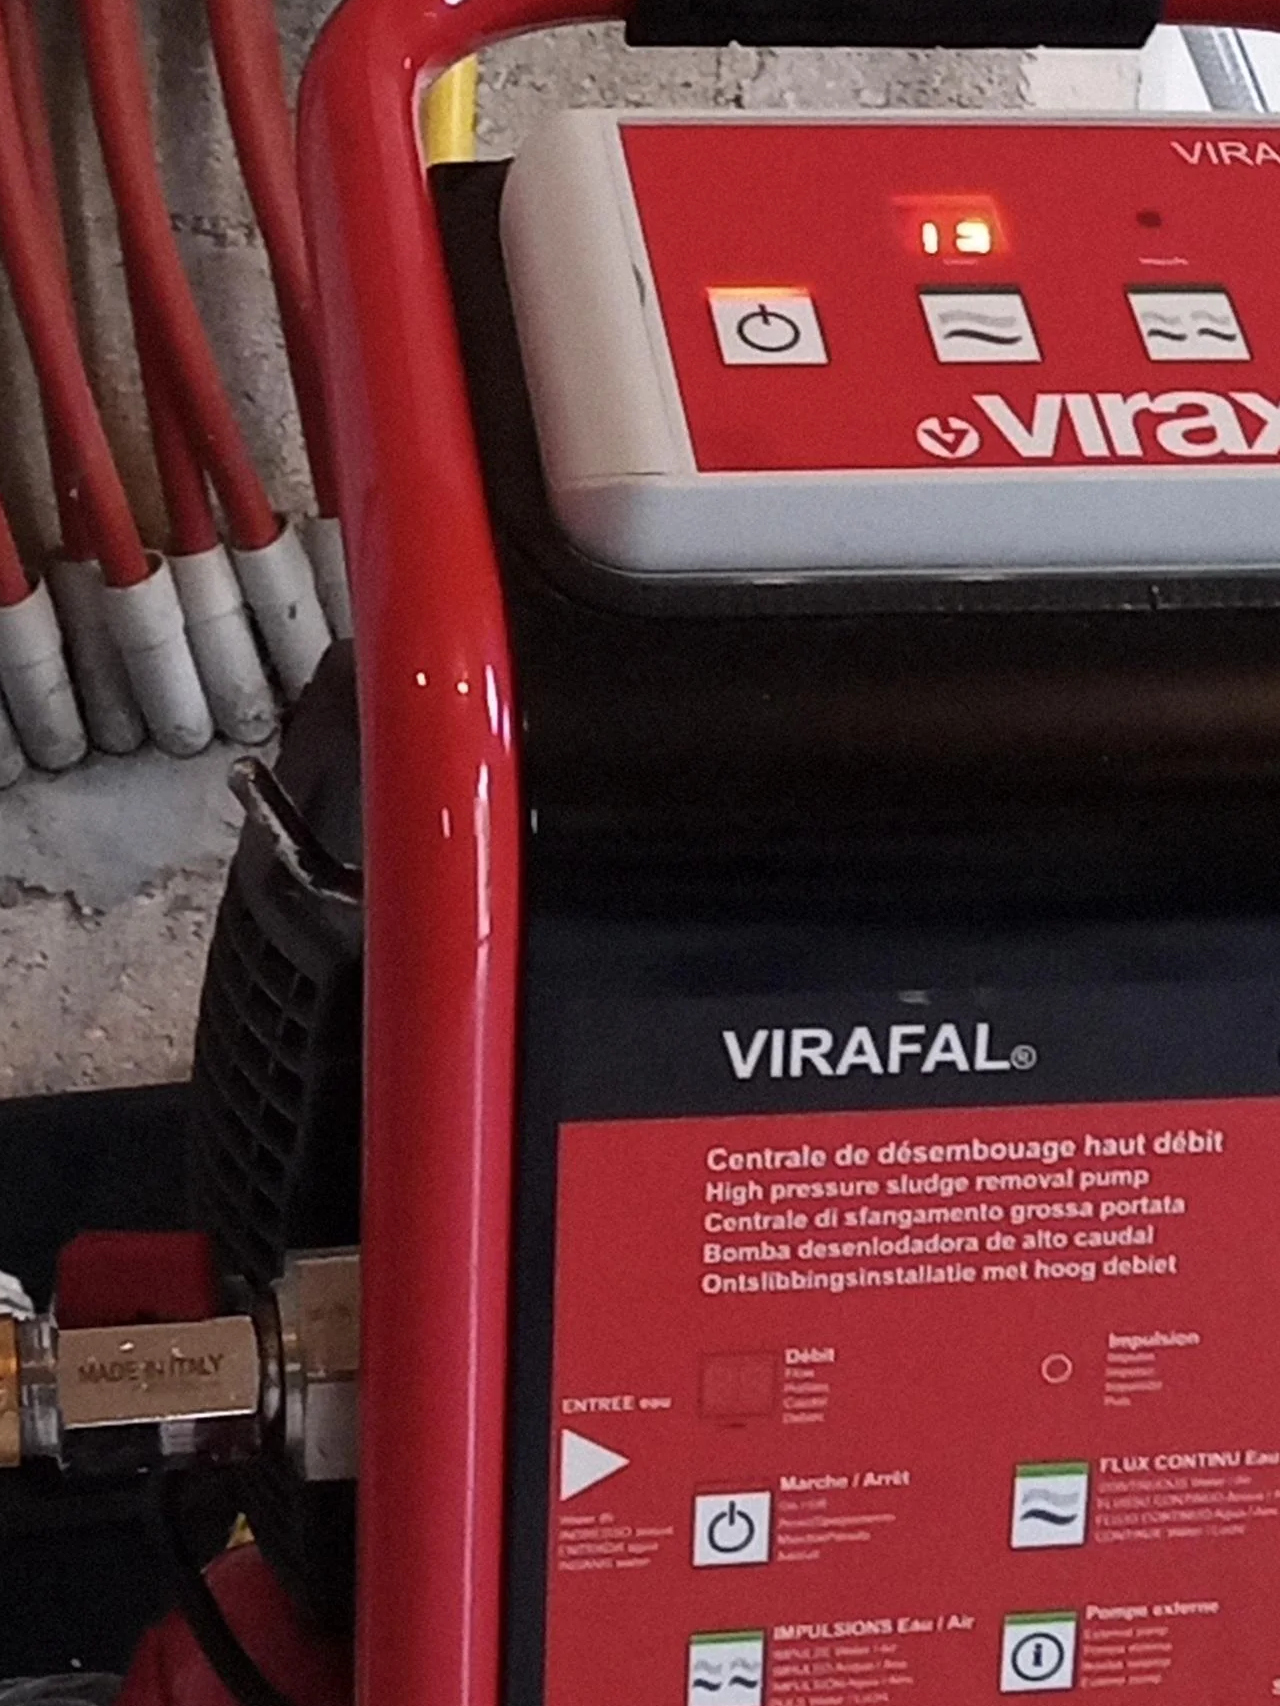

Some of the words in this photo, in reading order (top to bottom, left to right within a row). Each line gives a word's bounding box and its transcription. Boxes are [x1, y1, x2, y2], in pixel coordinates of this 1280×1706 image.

[706, 1144, 827, 1171] Centrale
[834, 1143, 870, 1167] de
[877, 1136, 1077, 1164] désembouage
[1083, 1133, 1146, 1157] haut
[1152, 1129, 1224, 1154] débit
[705, 1180, 764, 1206] High
[770, 1179, 880, 1204] pressure
[886, 1173, 969, 1197] sludge
[975, 1168, 1075, 1192] removal
[1079, 1169, 1151, 1191] pump
[704, 1209, 810, 1233] Centrale
[814, 1207, 838, 1228] di
[844, 1202, 1005, 1229] sfangamento
[1010, 1199, 1094, 1225] grossa
[1099, 1195, 1186, 1221] portata
[702, 1240, 792, 1264] Bomba
[796, 1233, 980, 1260] desenlodadora
[985, 1230, 1017, 1252] de
[1021, 1228, 1069, 1250] alto
[1073, 1225, 1155, 1248] caudal
[982, 1260, 1029, 1281] met
[1033, 1258, 1097, 1282] hoog
[1102, 1254, 1178, 1276] debiet
[1108, 1331, 1201, 1351] Impulsion
[78, 1361, 138, 1385] MADE
[144, 1358, 166, 1380] IN
[169, 1353, 225, 1379] ITALY
[1099, 1455, 1151, 1473] FLUX
[1153, 1451, 1241, 1472] CONTINU
[1243, 1449, 1280, 1466] Eau
[779, 1474, 849, 1491] Marche
[773, 1619, 893, 1641] IMPULSIONS
